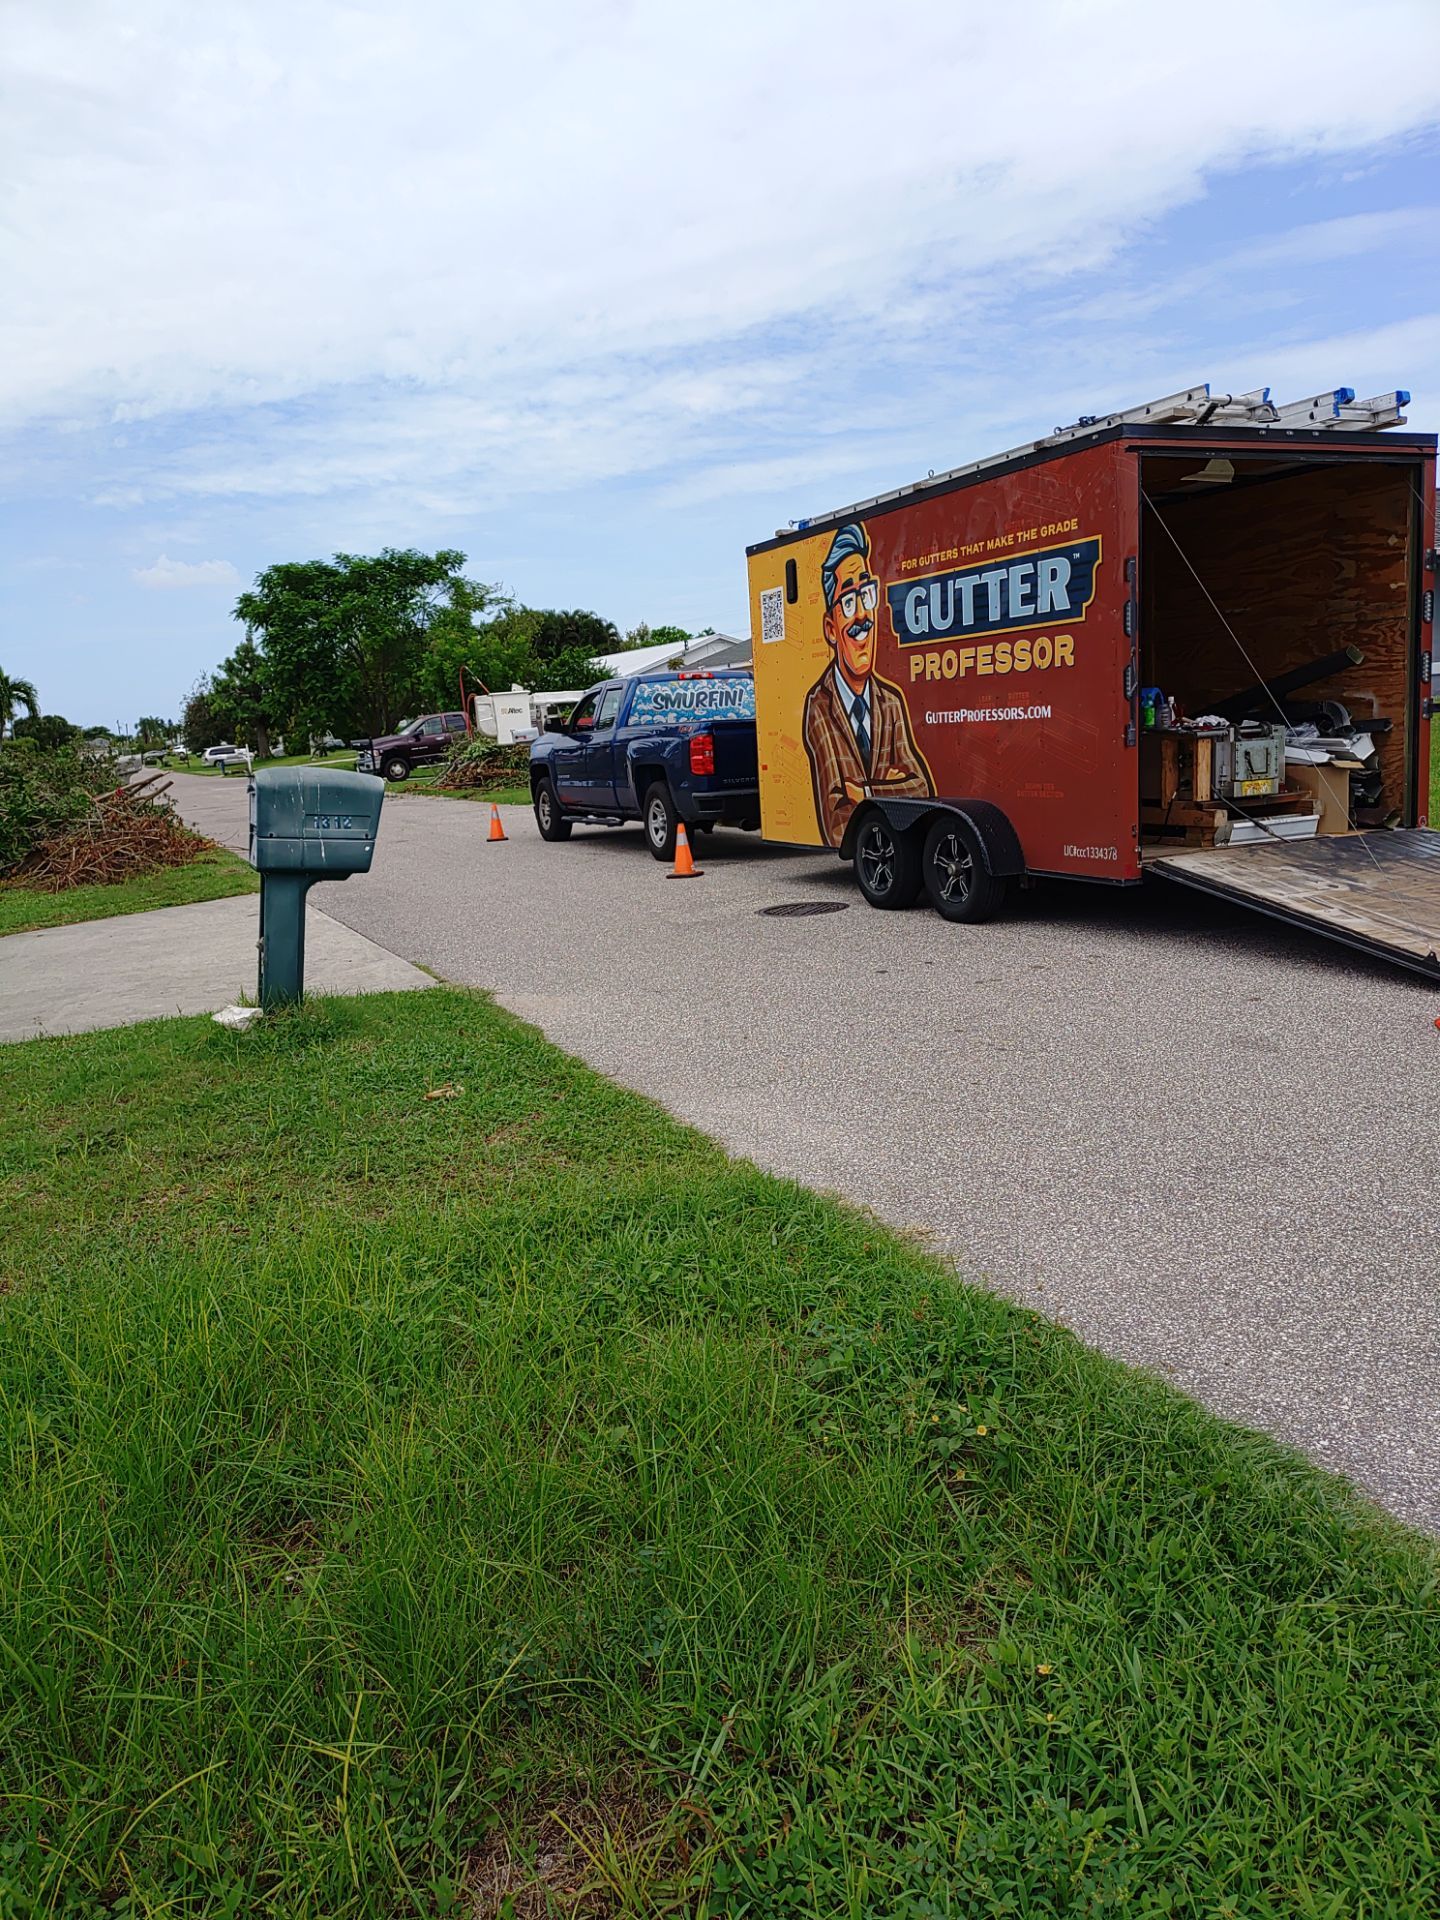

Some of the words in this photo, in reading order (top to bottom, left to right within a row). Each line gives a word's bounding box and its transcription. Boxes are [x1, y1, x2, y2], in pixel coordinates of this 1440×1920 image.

[901, 559, 918, 571] FOR
[919, 549, 958, 566] GUTTERS
[960, 542, 985, 556] THAT
[987, 534, 1014, 550] MAKE
[1016, 528, 1038, 544] THE
[1040, 518, 1079, 537] GRADE
[904, 557, 1071, 635] GUTTER
[910, 634, 1075, 683] PROFESSOR
[652, 687, 744, 711] SMURFIN!
[313, 816, 352, 829] 1312
